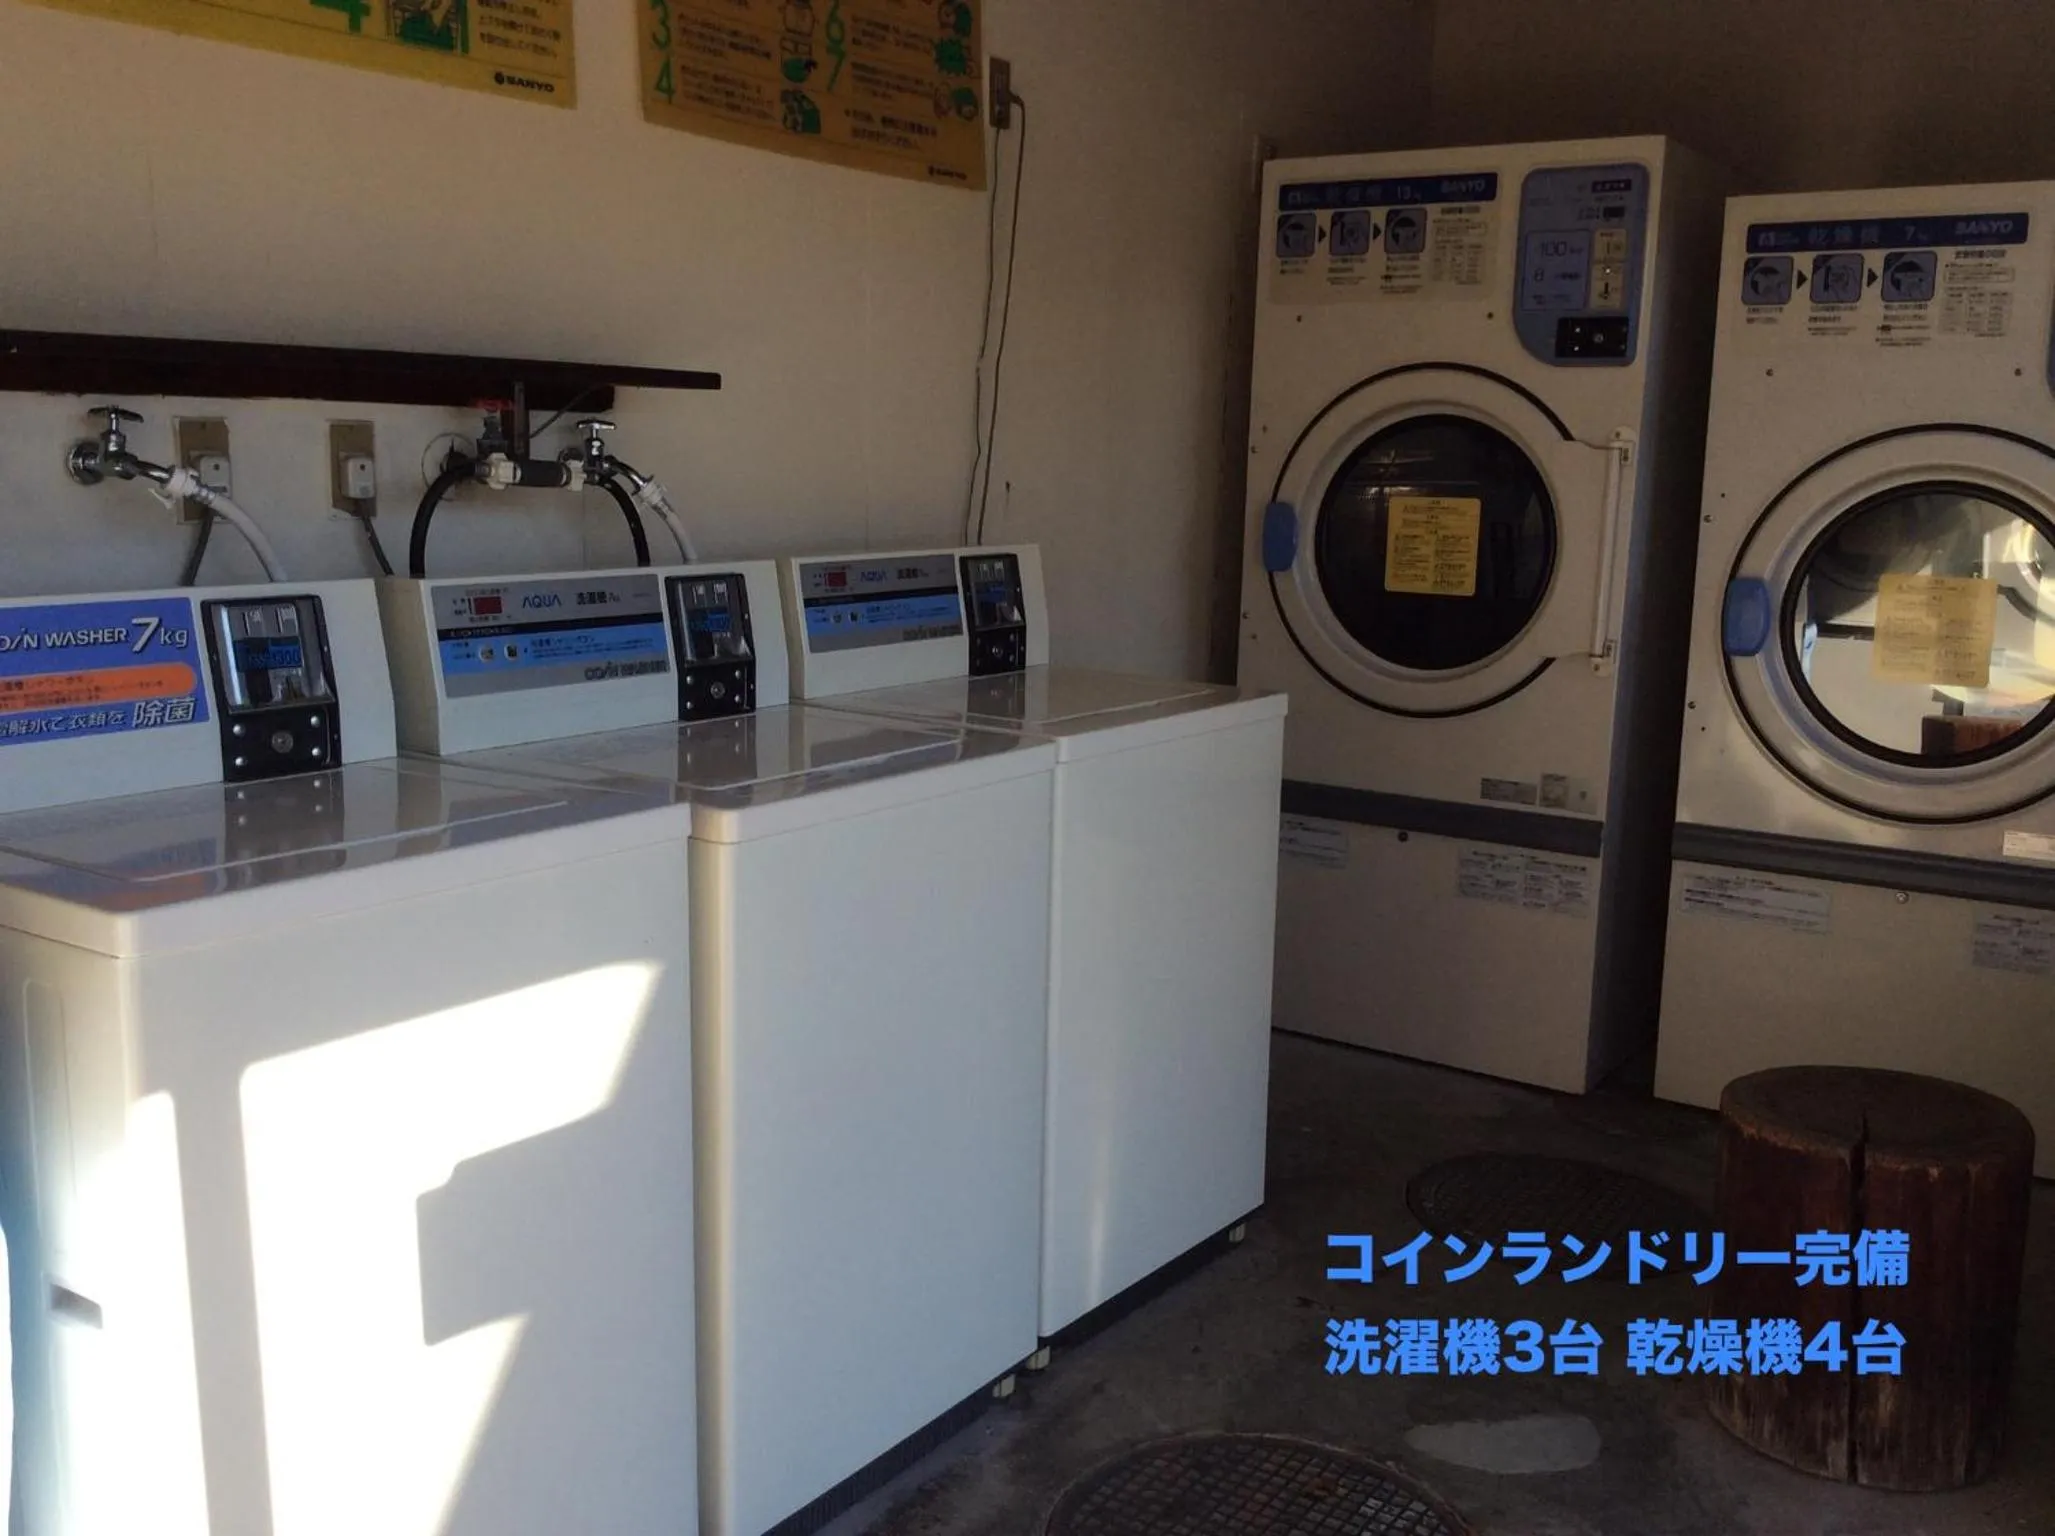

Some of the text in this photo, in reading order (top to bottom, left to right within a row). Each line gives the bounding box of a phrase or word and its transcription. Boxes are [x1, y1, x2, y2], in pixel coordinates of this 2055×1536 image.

[507, 75, 555, 93] SANYO
[655, 53, 675, 104] 4
[522, 593, 563, 609] AQUA
[46, 628, 128, 647] WASHER
